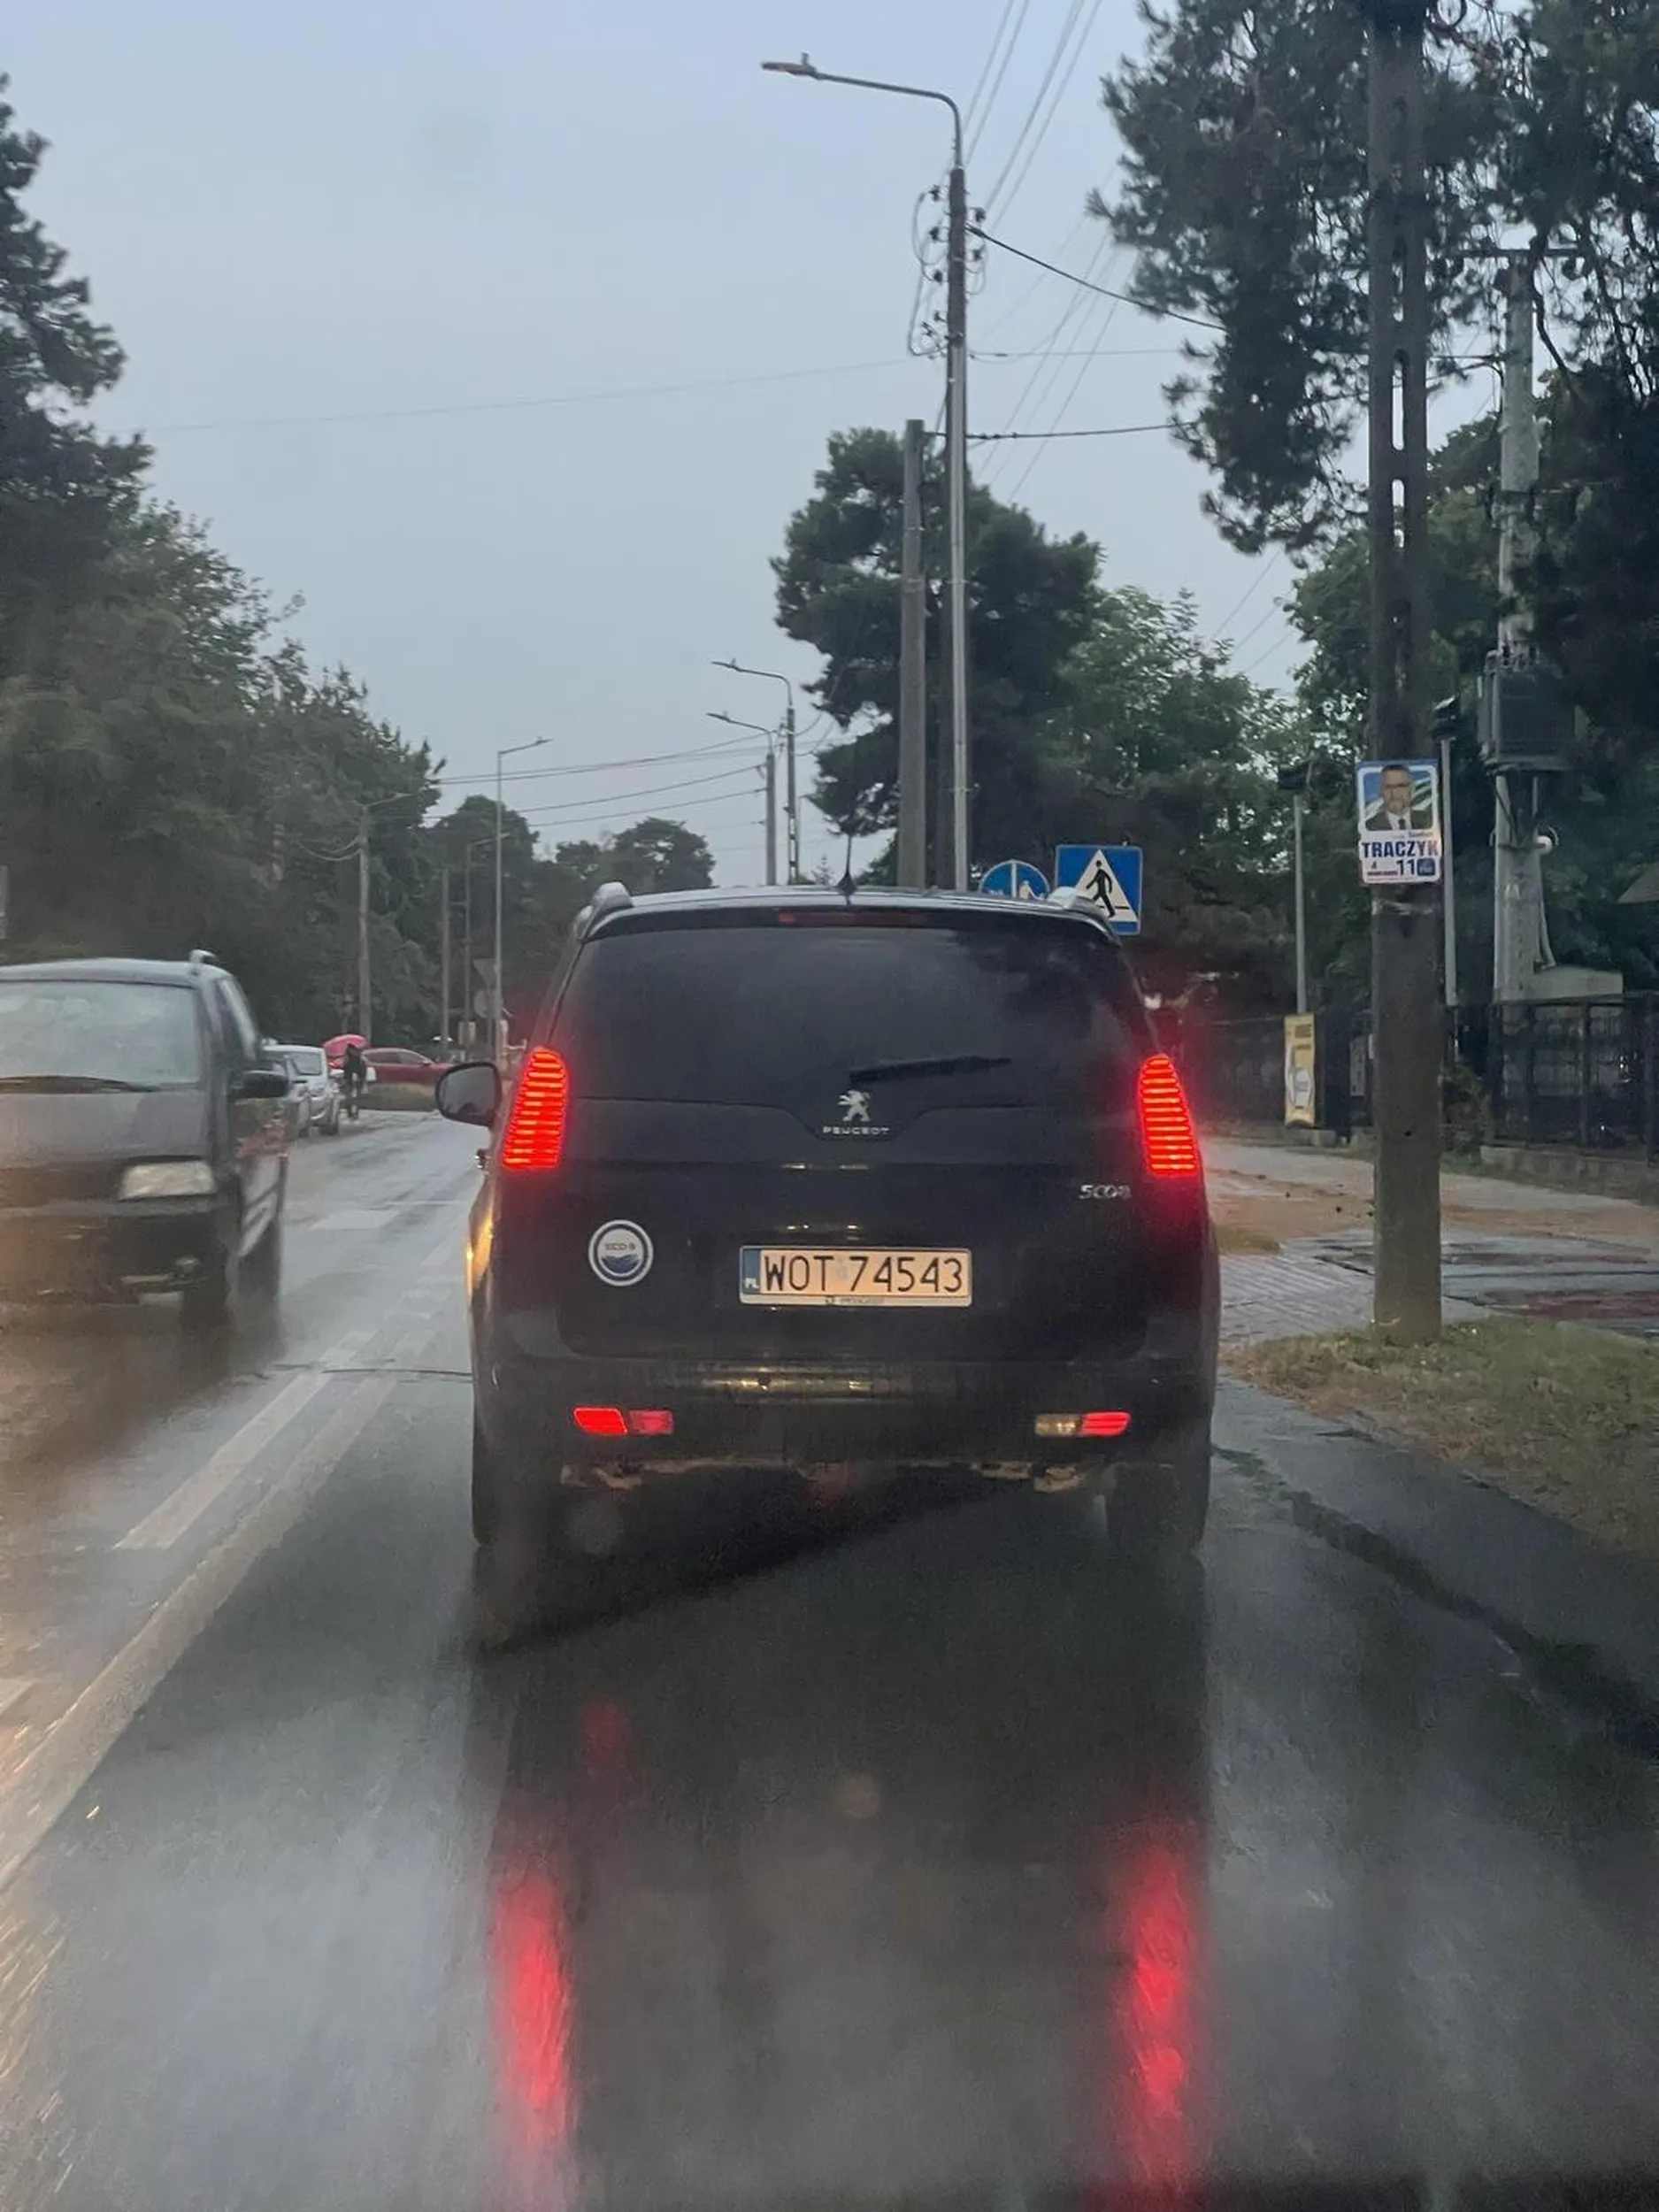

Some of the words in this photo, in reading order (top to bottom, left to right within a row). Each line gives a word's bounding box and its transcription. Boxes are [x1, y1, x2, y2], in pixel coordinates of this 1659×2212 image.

[1362, 841, 1439, 858] TRACZYK
[1396, 858, 1416, 876] 11
[822, 1125, 890, 1135] PEUGEOT
[764, 1256, 834, 1292] WOT
[849, 1256, 963, 1294] 74543
